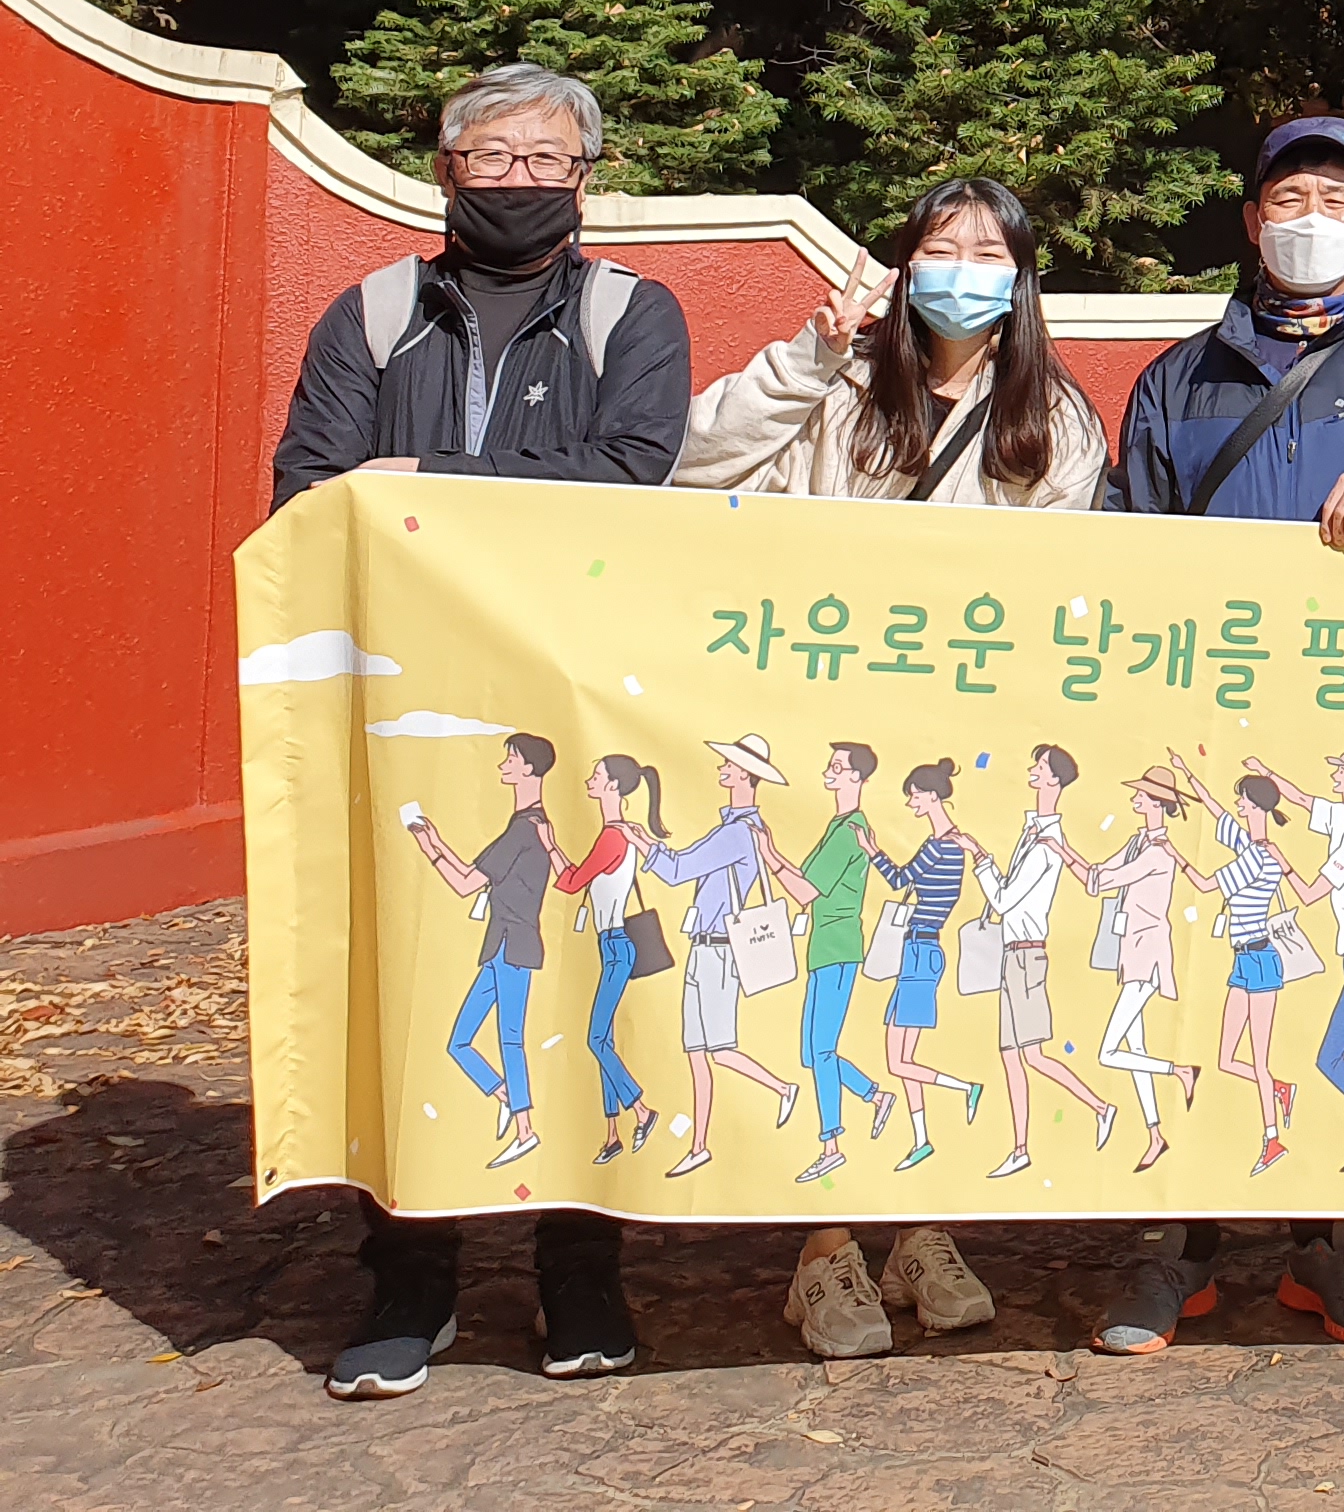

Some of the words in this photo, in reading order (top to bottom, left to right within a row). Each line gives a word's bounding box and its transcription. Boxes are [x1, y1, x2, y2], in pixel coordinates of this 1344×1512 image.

[706, 592, 1015, 694] 자유로운
[1052, 598, 1271, 710] 날개를
[749, 931, 776, 945] MUSIC
